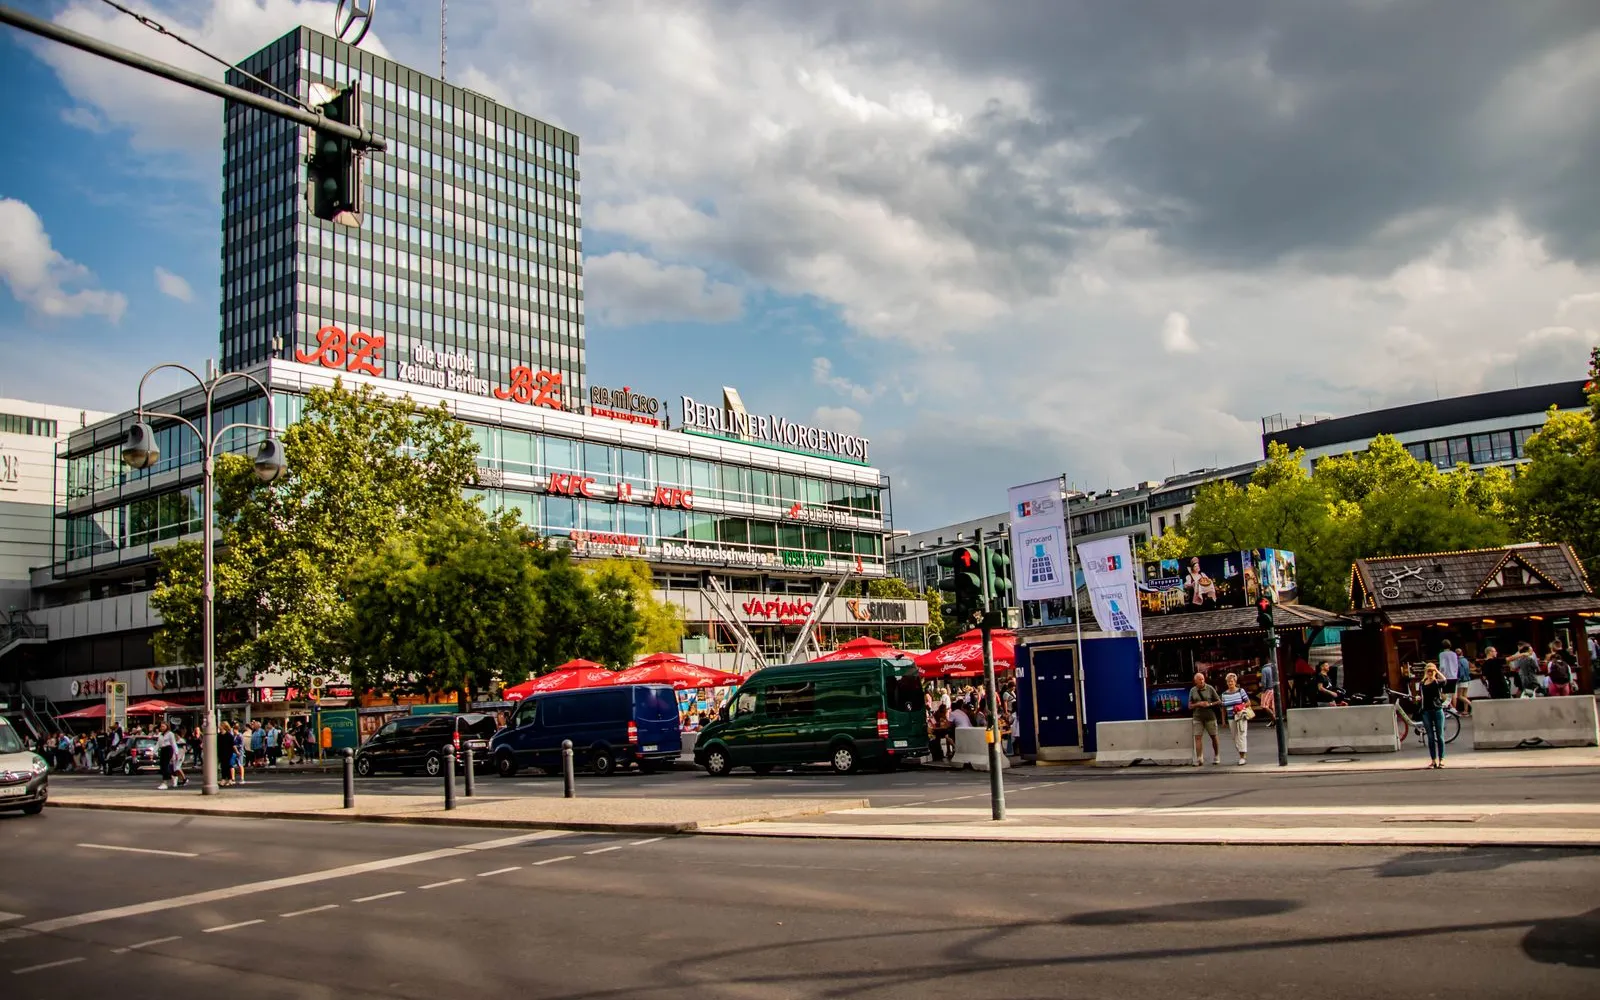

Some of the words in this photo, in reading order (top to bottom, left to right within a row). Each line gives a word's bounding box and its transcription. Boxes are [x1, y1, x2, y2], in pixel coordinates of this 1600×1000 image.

[414, 345, 433, 364] die
[436, 350, 475, 373] größte
[398, 361, 445, 388] Zeitung
[447, 370, 488, 395] Berlins
[681, 396, 768, 440] BERLINER
[769, 414, 870, 459] MORGENPOST
[547, 472, 596, 497] KFC
[652, 485, 694, 509] KFC
[1025, 534, 1053, 547] girocard
[663, 542, 683, 557] Die
[683, 544, 767, 564] Stachelschweine
[743, 597, 813, 619] VAPIANO
